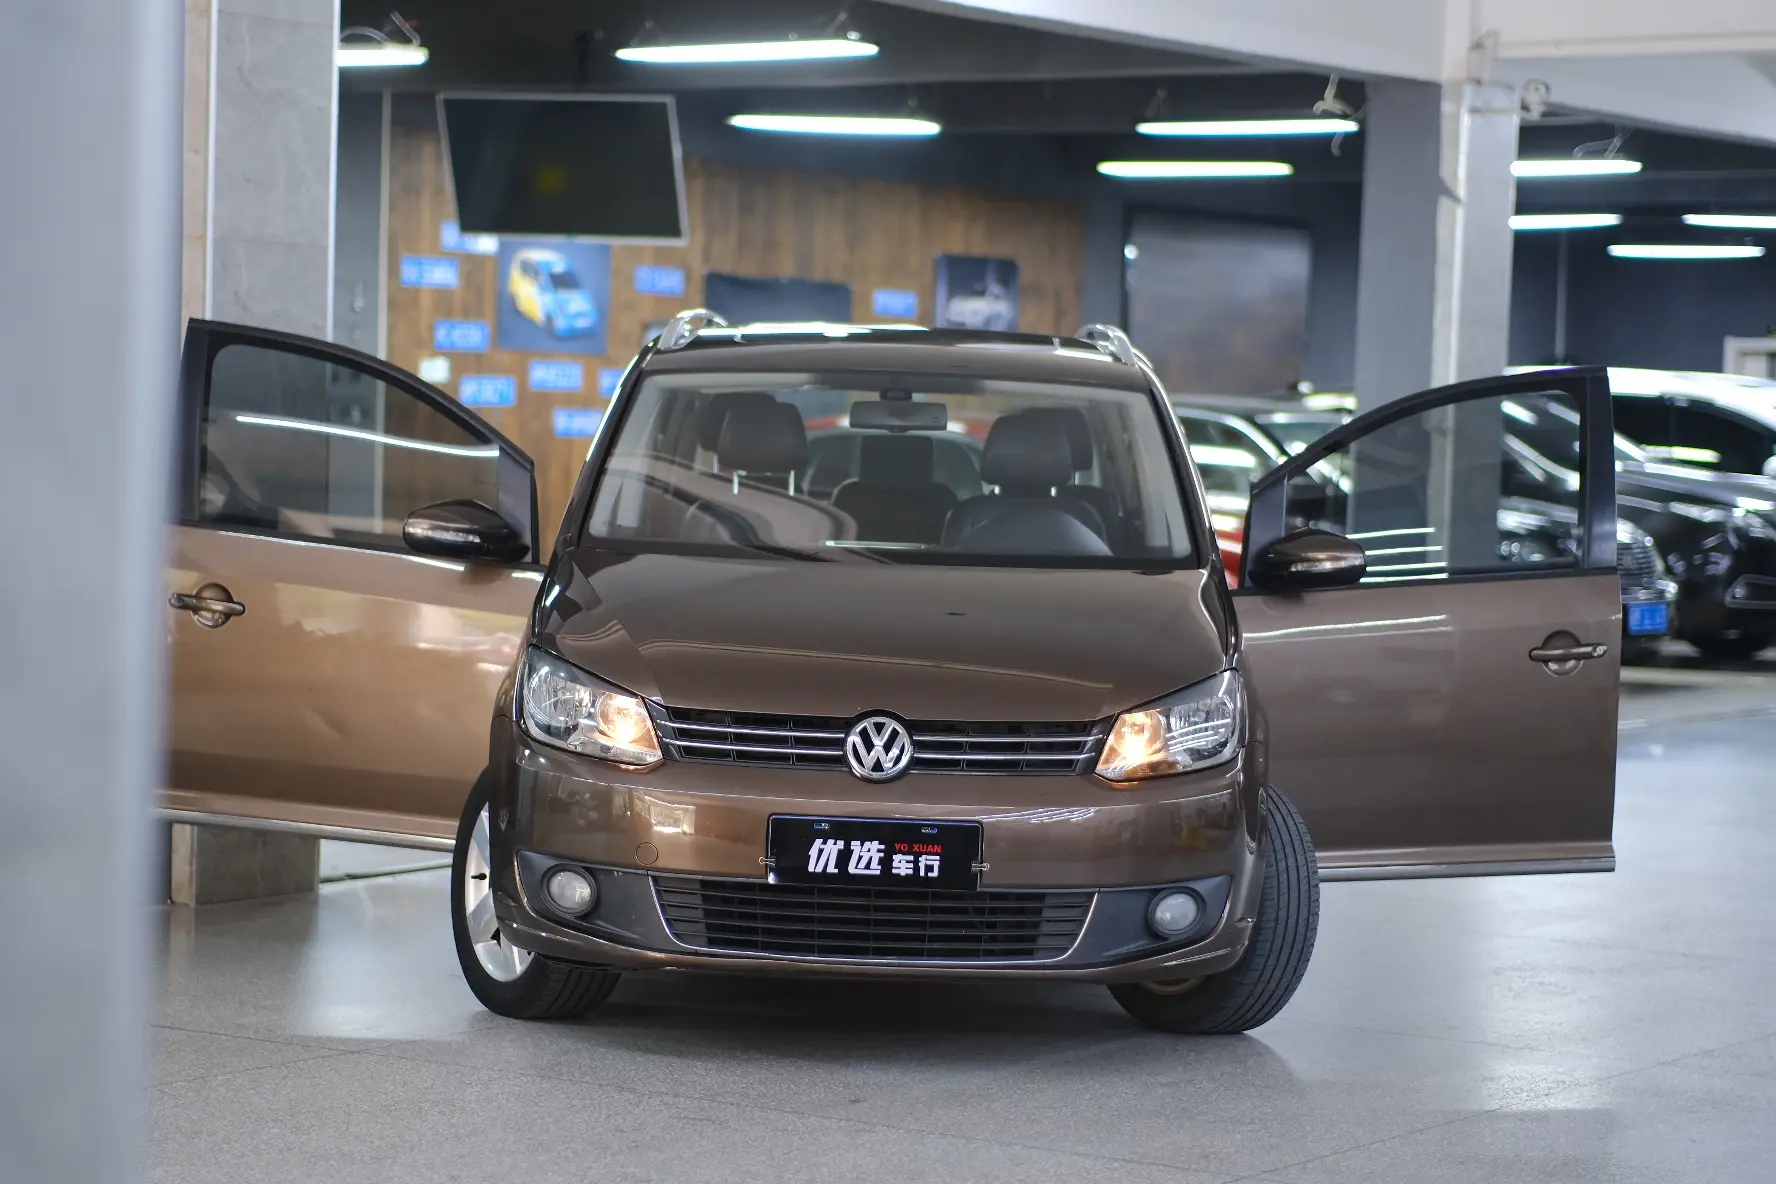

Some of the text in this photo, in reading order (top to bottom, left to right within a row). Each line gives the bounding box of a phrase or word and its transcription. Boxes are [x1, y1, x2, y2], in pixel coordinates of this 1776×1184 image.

[808, 838, 885, 875] 优选
[894, 843, 942, 853] YO XUAN
[892, 853, 940, 877] 车行
